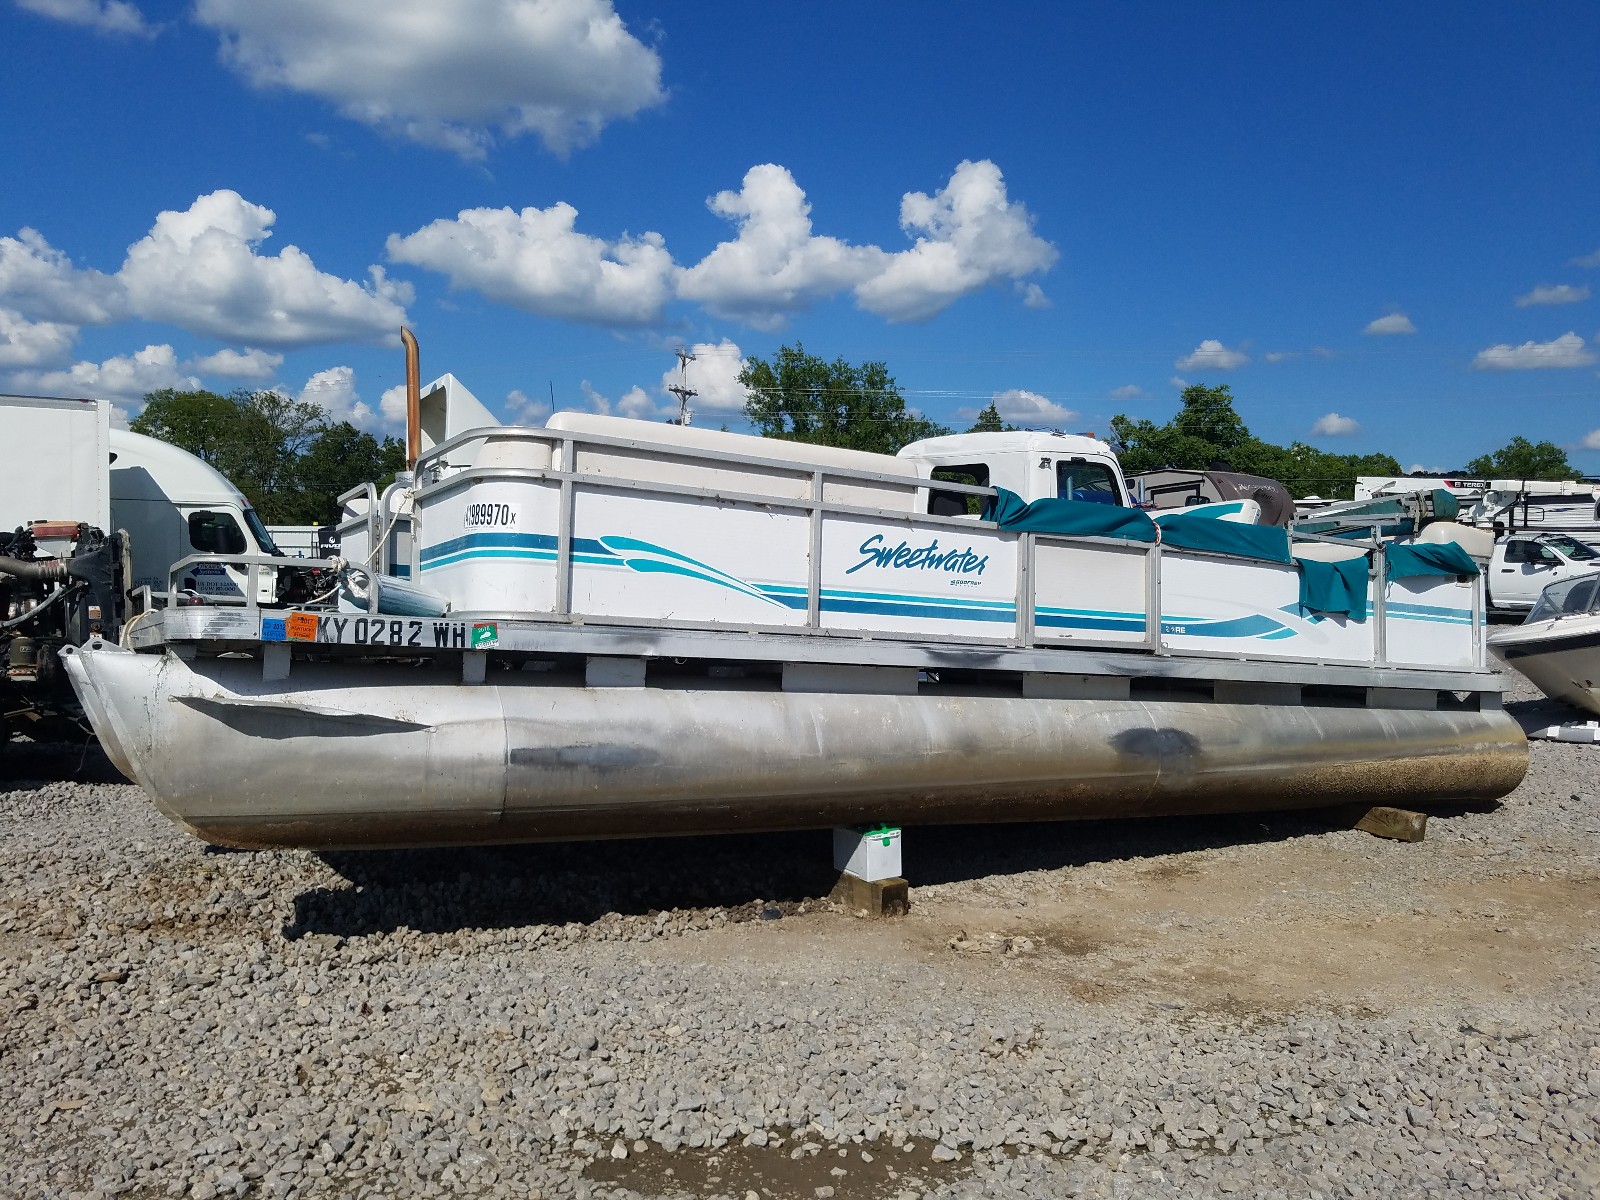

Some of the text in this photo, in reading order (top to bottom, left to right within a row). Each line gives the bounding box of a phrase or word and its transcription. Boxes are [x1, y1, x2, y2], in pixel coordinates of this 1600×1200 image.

[846, 534, 989, 575] Sweetwater
[300, 617, 314, 625] 2017
[316, 616, 467, 649] KY 0282 WH
